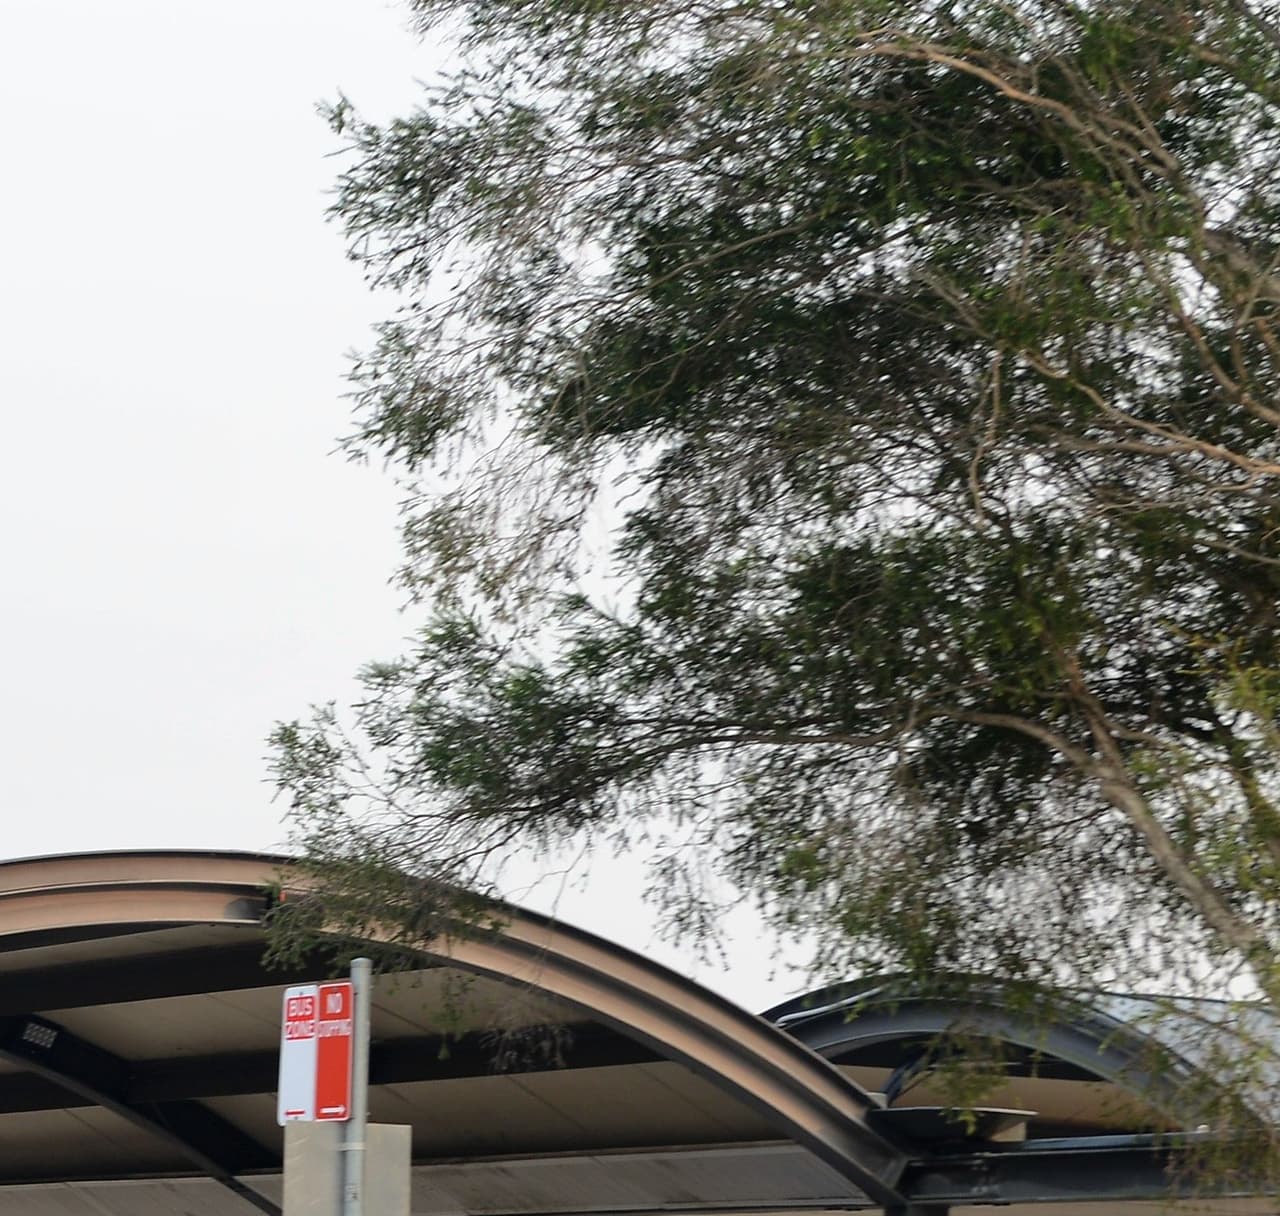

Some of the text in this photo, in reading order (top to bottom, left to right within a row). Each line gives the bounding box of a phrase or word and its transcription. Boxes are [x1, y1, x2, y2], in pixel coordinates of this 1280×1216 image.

[289, 998, 313, 1017] BUS
[326, 992, 343, 1014] NO
[286, 1020, 315, 1038] ZONE
